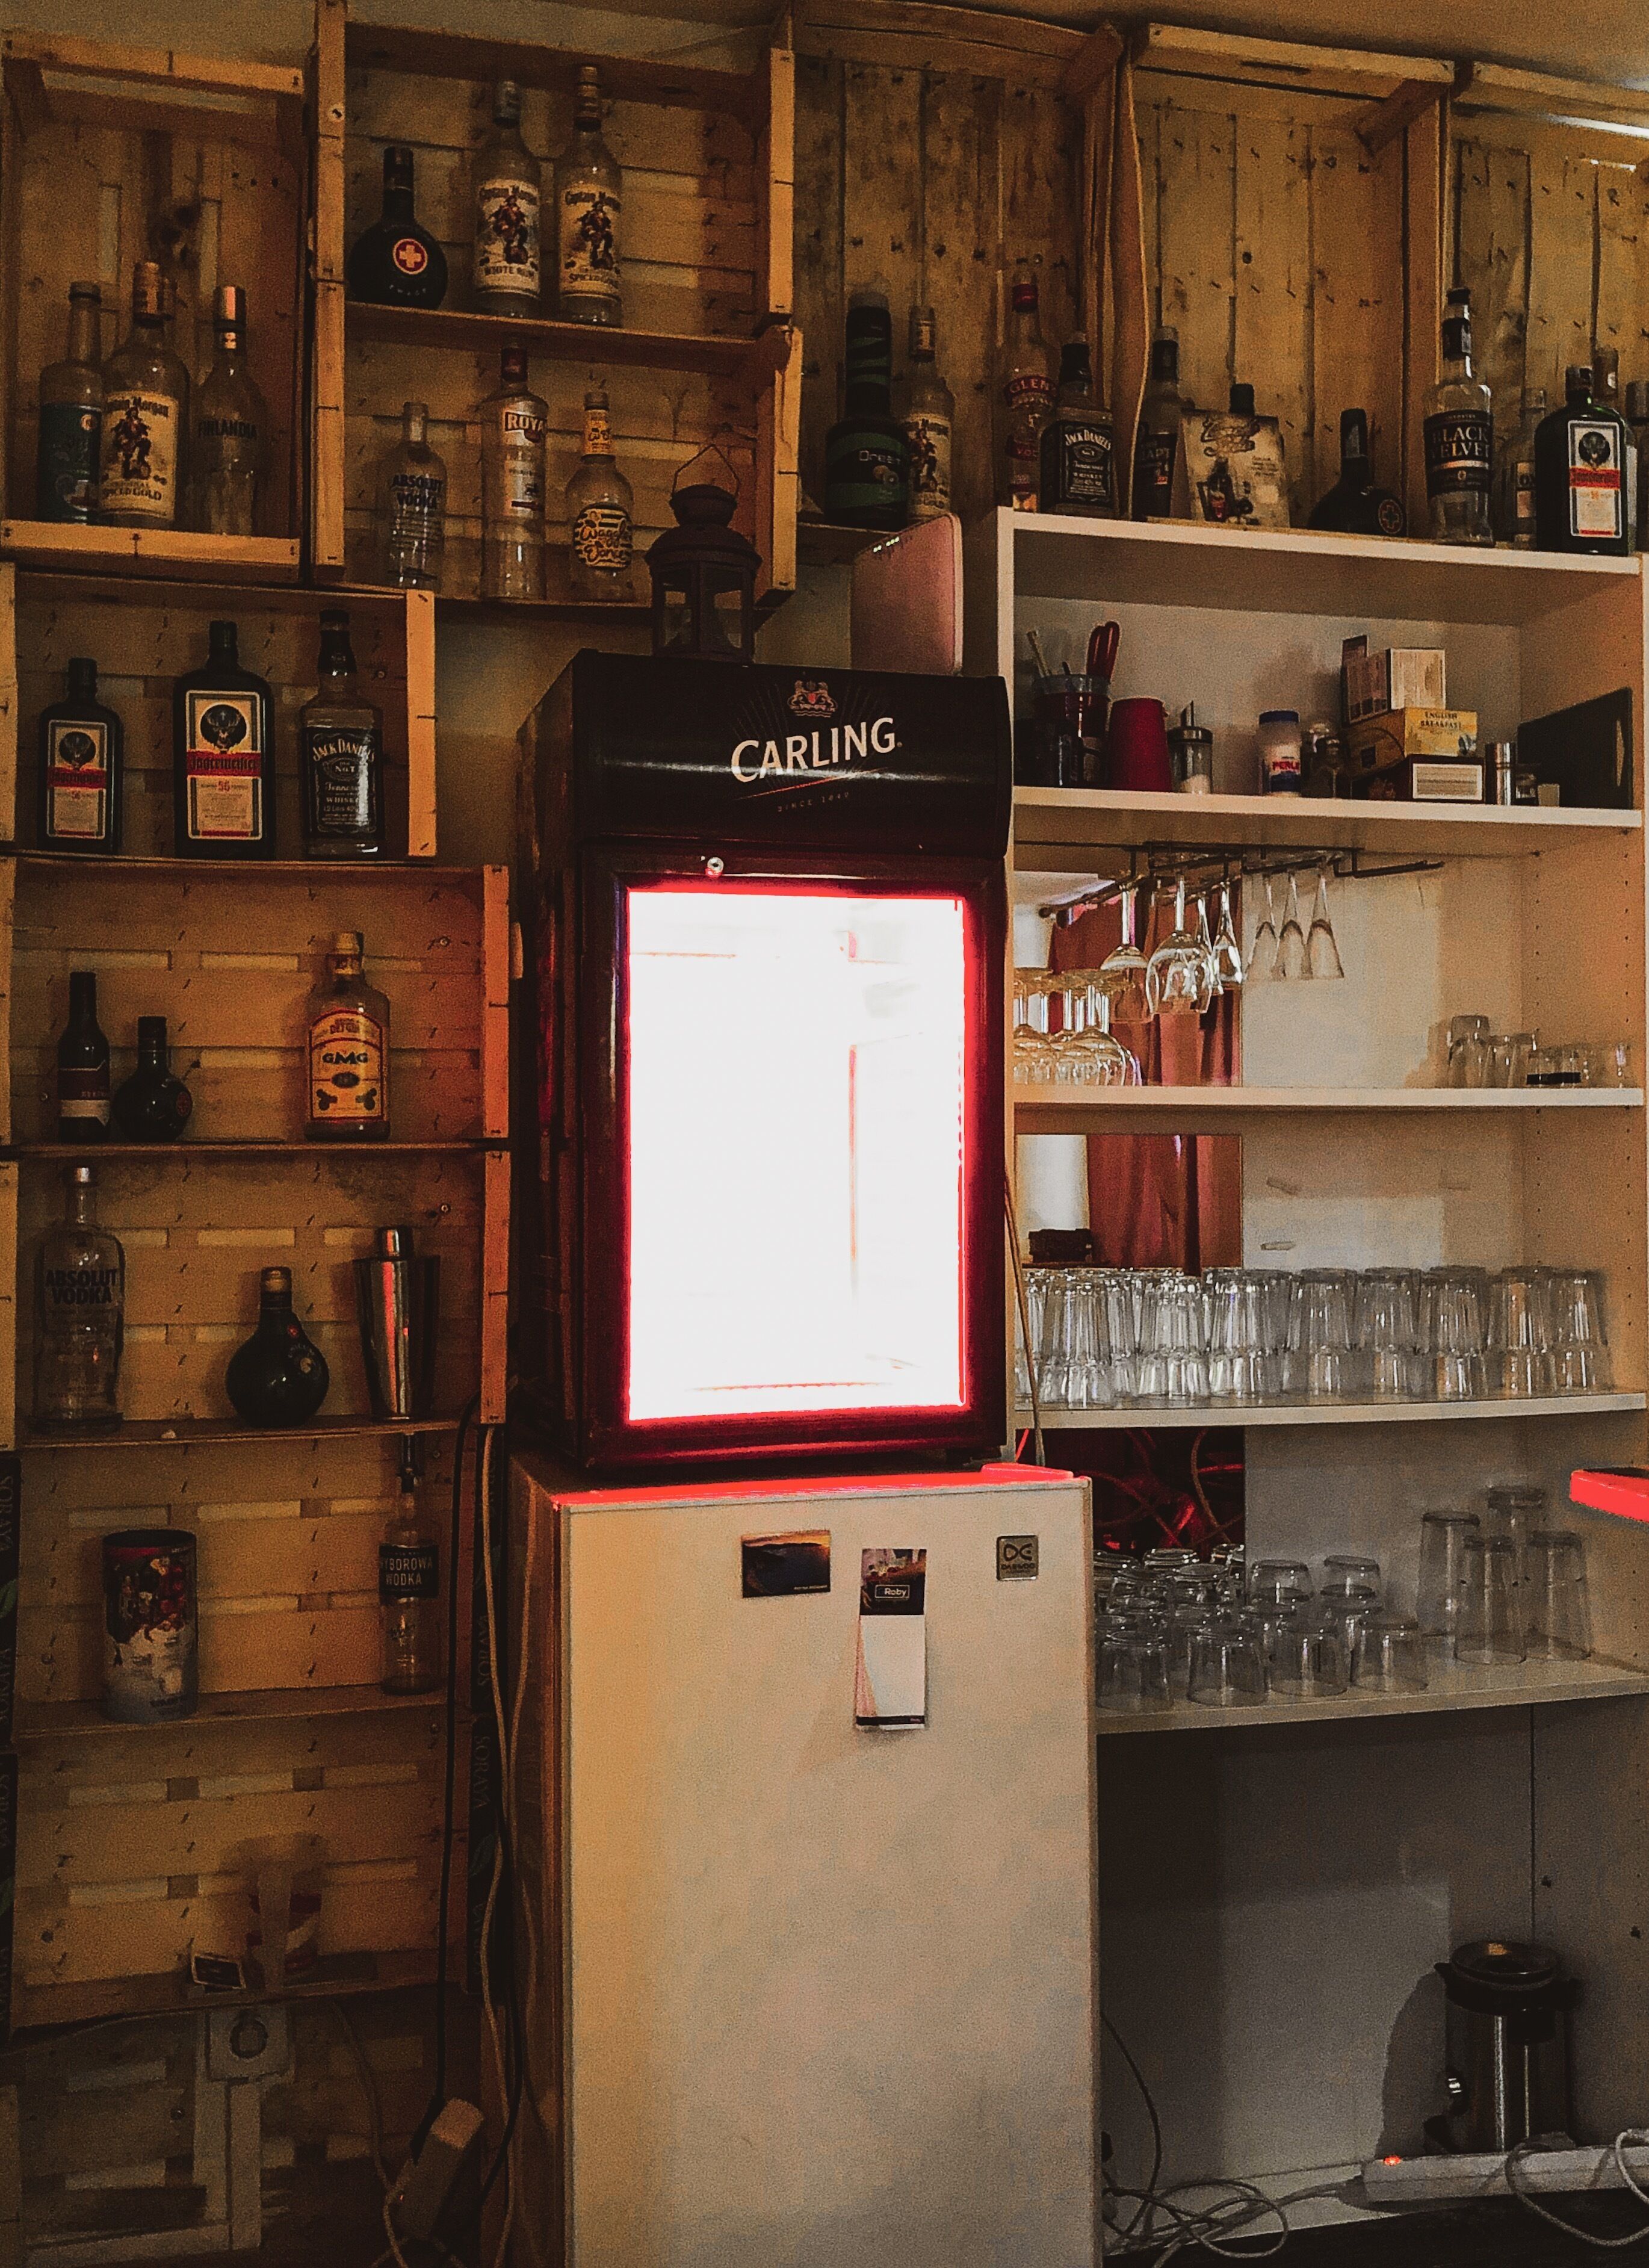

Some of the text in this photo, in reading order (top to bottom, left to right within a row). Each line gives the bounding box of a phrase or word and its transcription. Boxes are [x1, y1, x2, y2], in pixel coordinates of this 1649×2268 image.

[1432, 426, 1489, 444] BLACK
[313, 743, 338, 761] JACK
[731, 717, 896, 783] CARLING
[322, 1050, 369, 1065] GMG
[46, 1268, 118, 1287] ABSOLUT
[53, 1286, 113, 1304] VODKA
[473, 1736, 490, 1809] SORAYA
